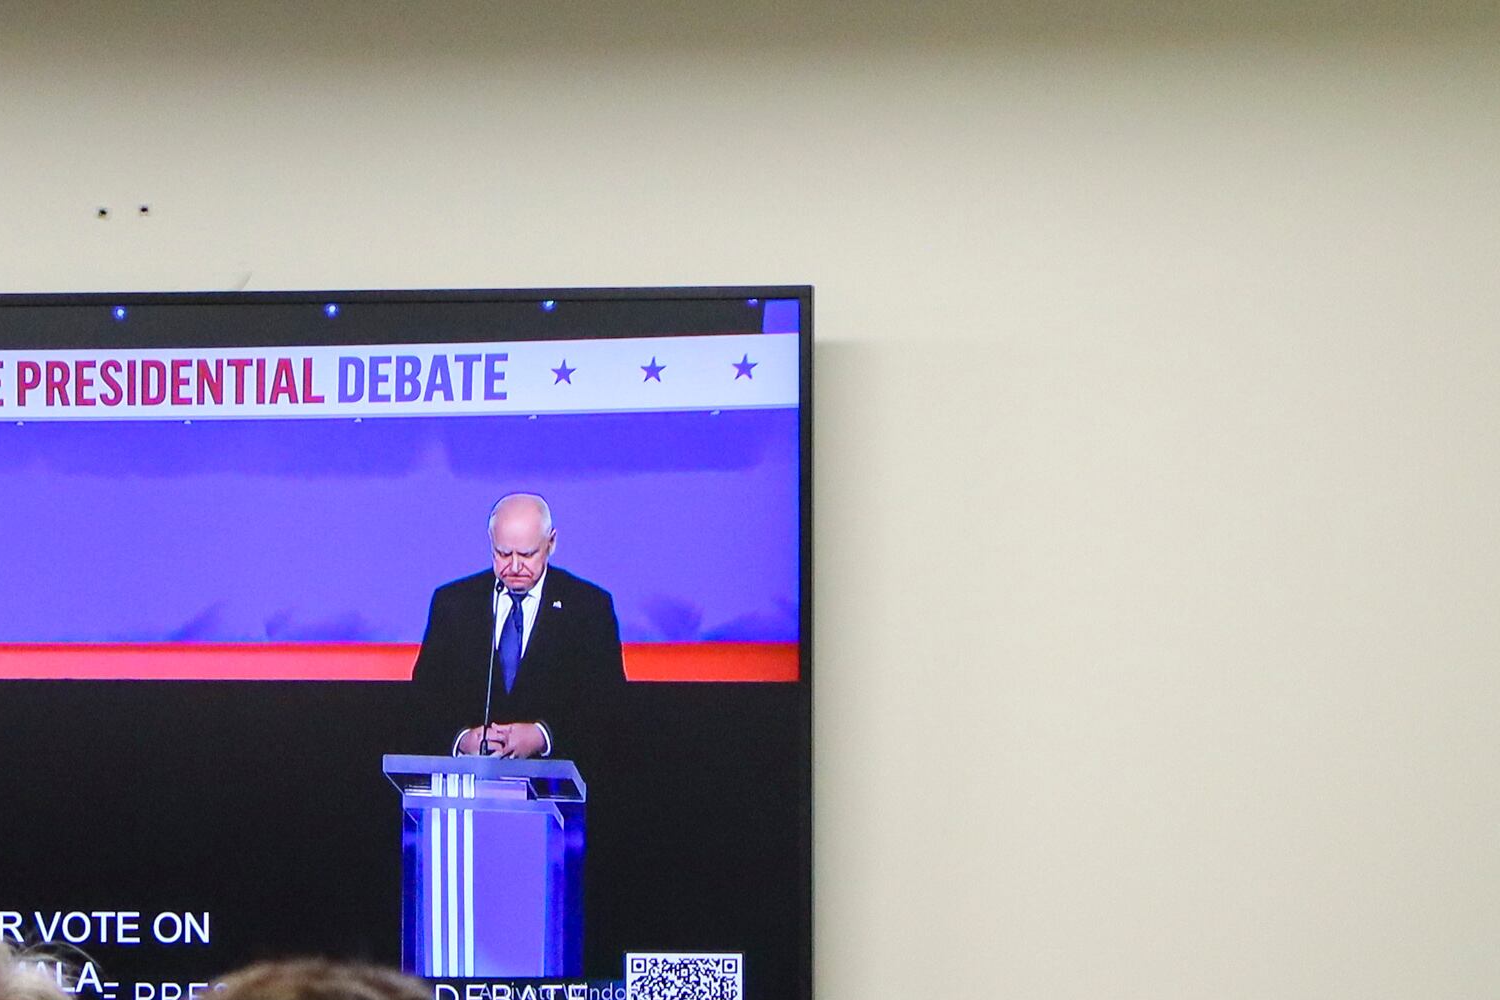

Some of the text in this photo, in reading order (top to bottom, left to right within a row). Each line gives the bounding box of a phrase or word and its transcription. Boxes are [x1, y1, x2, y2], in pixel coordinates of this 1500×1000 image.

[17, 357, 325, 407] PRESIDENTIAL
[338, 352, 509, 403] DEBATE
[35, 911, 140, 943] VOTE
[154, 911, 210, 943] ON
